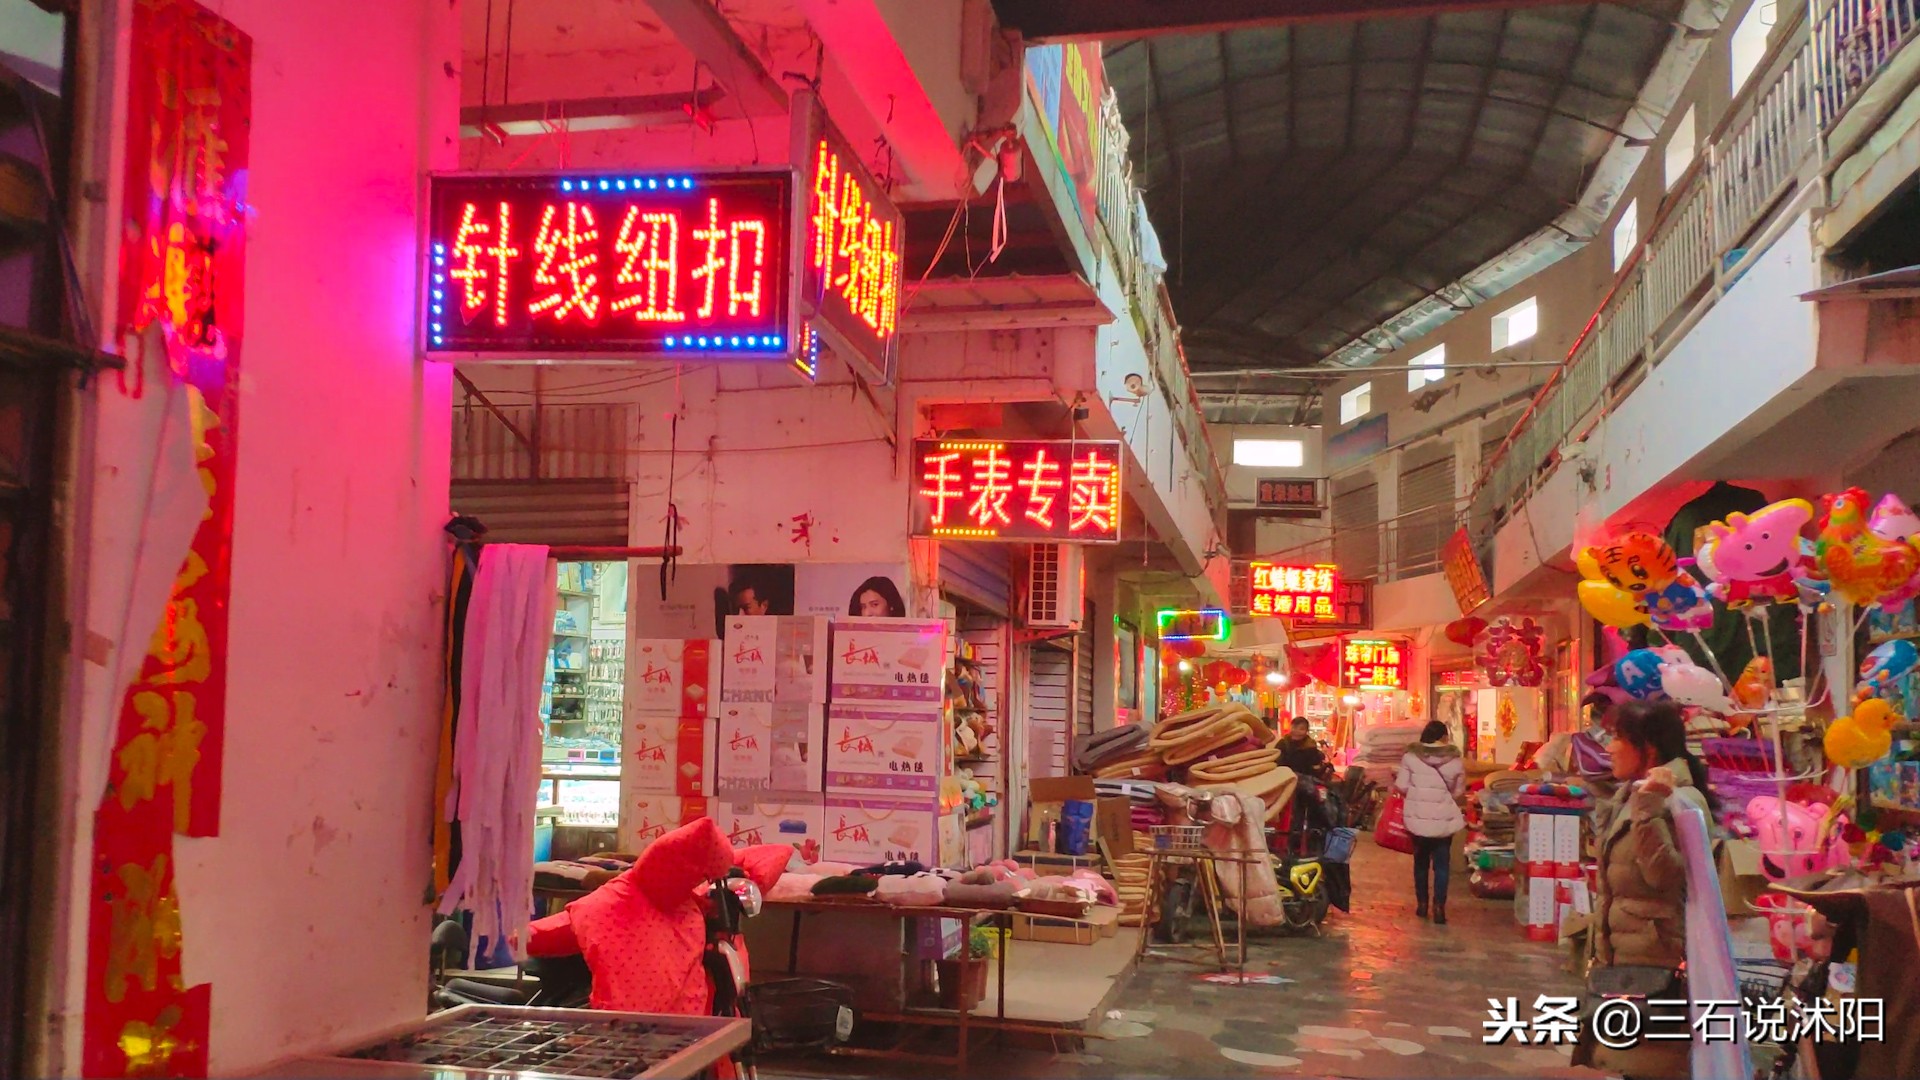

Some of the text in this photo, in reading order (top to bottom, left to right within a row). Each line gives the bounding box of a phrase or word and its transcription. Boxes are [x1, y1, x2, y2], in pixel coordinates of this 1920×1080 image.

[450, 198, 764, 326] 针线纽扣
[919, 449, 1112, 532] 手表专卖
[1253, 594, 1332, 615] 结婚用品
